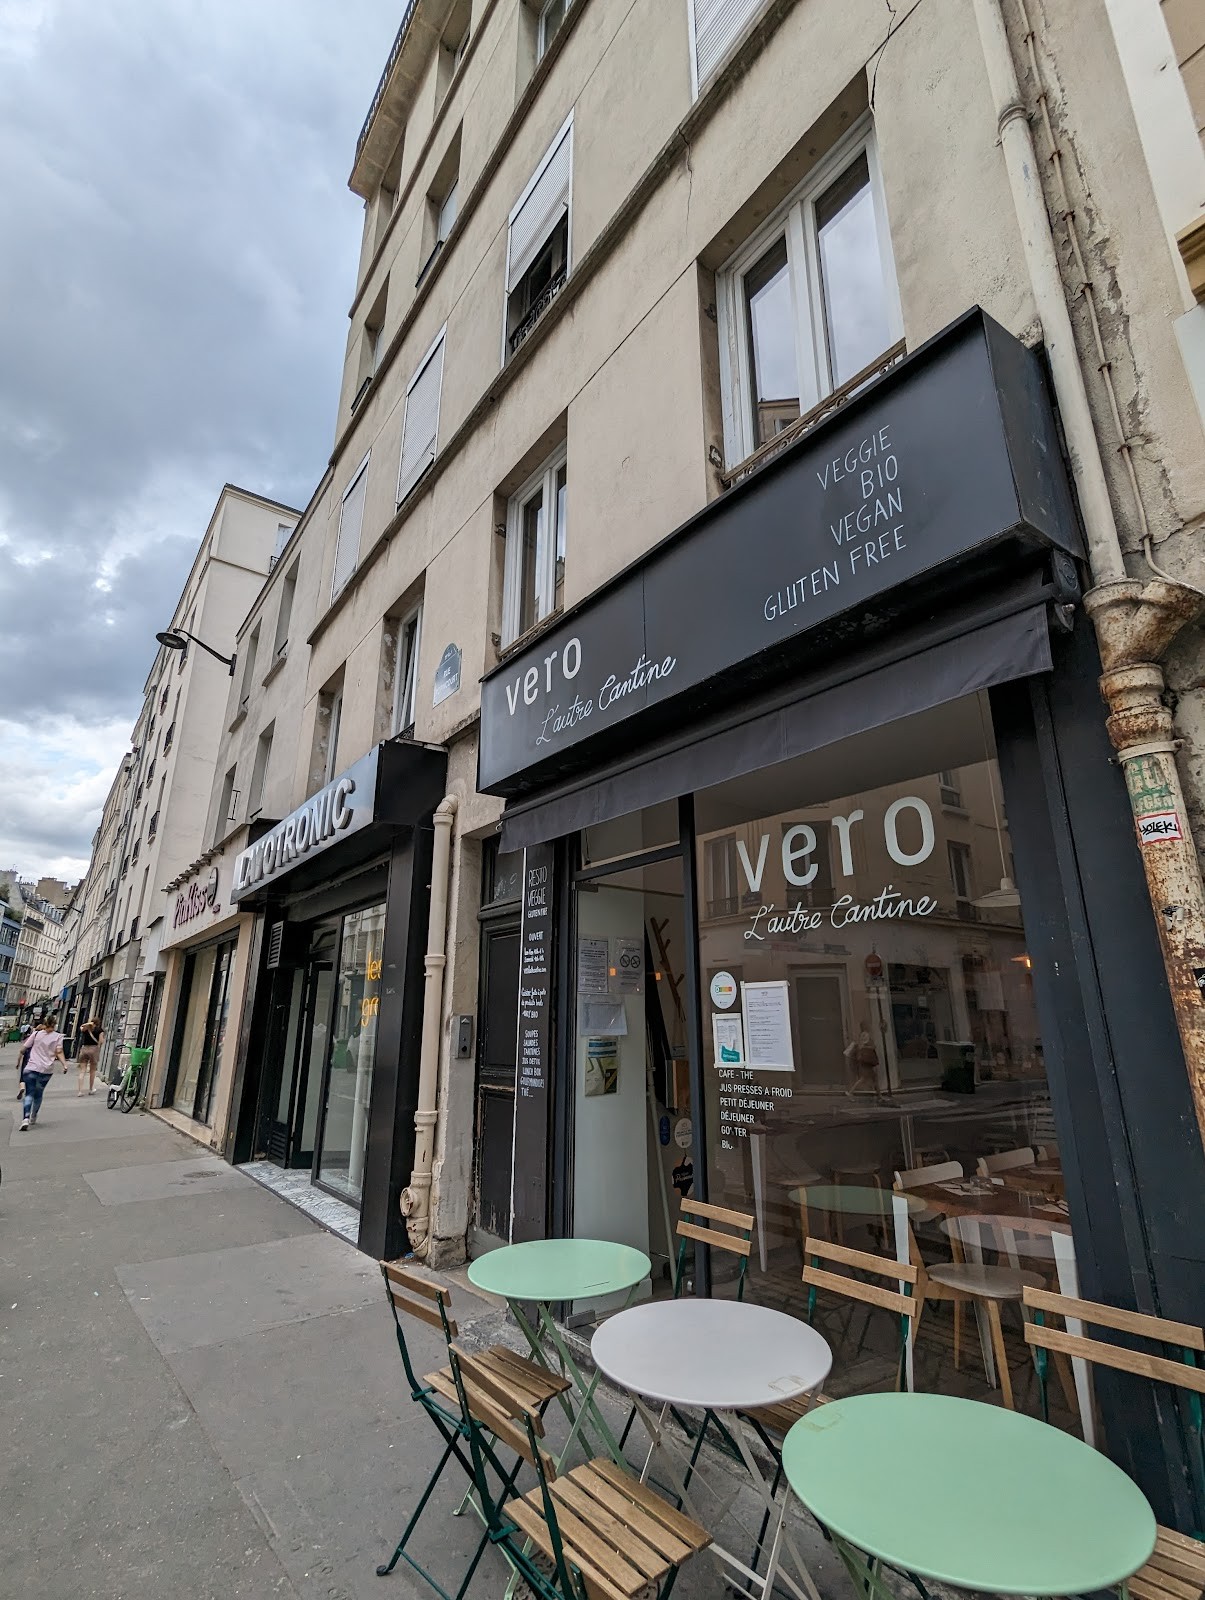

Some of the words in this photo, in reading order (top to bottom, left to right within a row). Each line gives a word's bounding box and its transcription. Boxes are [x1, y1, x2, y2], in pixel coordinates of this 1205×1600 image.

[817, 425, 891, 490] VEGGIE
[860, 455, 898, 499] BIO
[830, 487, 903, 546] VEGAN
[764, 561, 840, 621] GLUTEN
[849, 524, 907, 575] FREE
[505, 637, 582, 716] vero
[536, 694, 593, 746] L'autre
[598, 654, 677, 711] Cantine
[736, 796, 936, 893] vero
[527, 887, 546, 907] VEGGIE
[528, 866, 548, 888] RESTO
[743, 901, 823, 941] L'autre
[831, 884, 938, 928] Cantine
[719, 1083, 732, 1093] JUS
[733, 1084, 763, 1095] PRESSES
[764, 1086, 770, 1096] A
[771, 1087, 793, 1098] FROID
[740, 1070, 754, 1080] THE
[719, 1096, 737, 1107] PETIT
[738, 1098, 775, 1112] DÉJEUNER
[720, 1110, 755, 1124] DÉJEUNER
